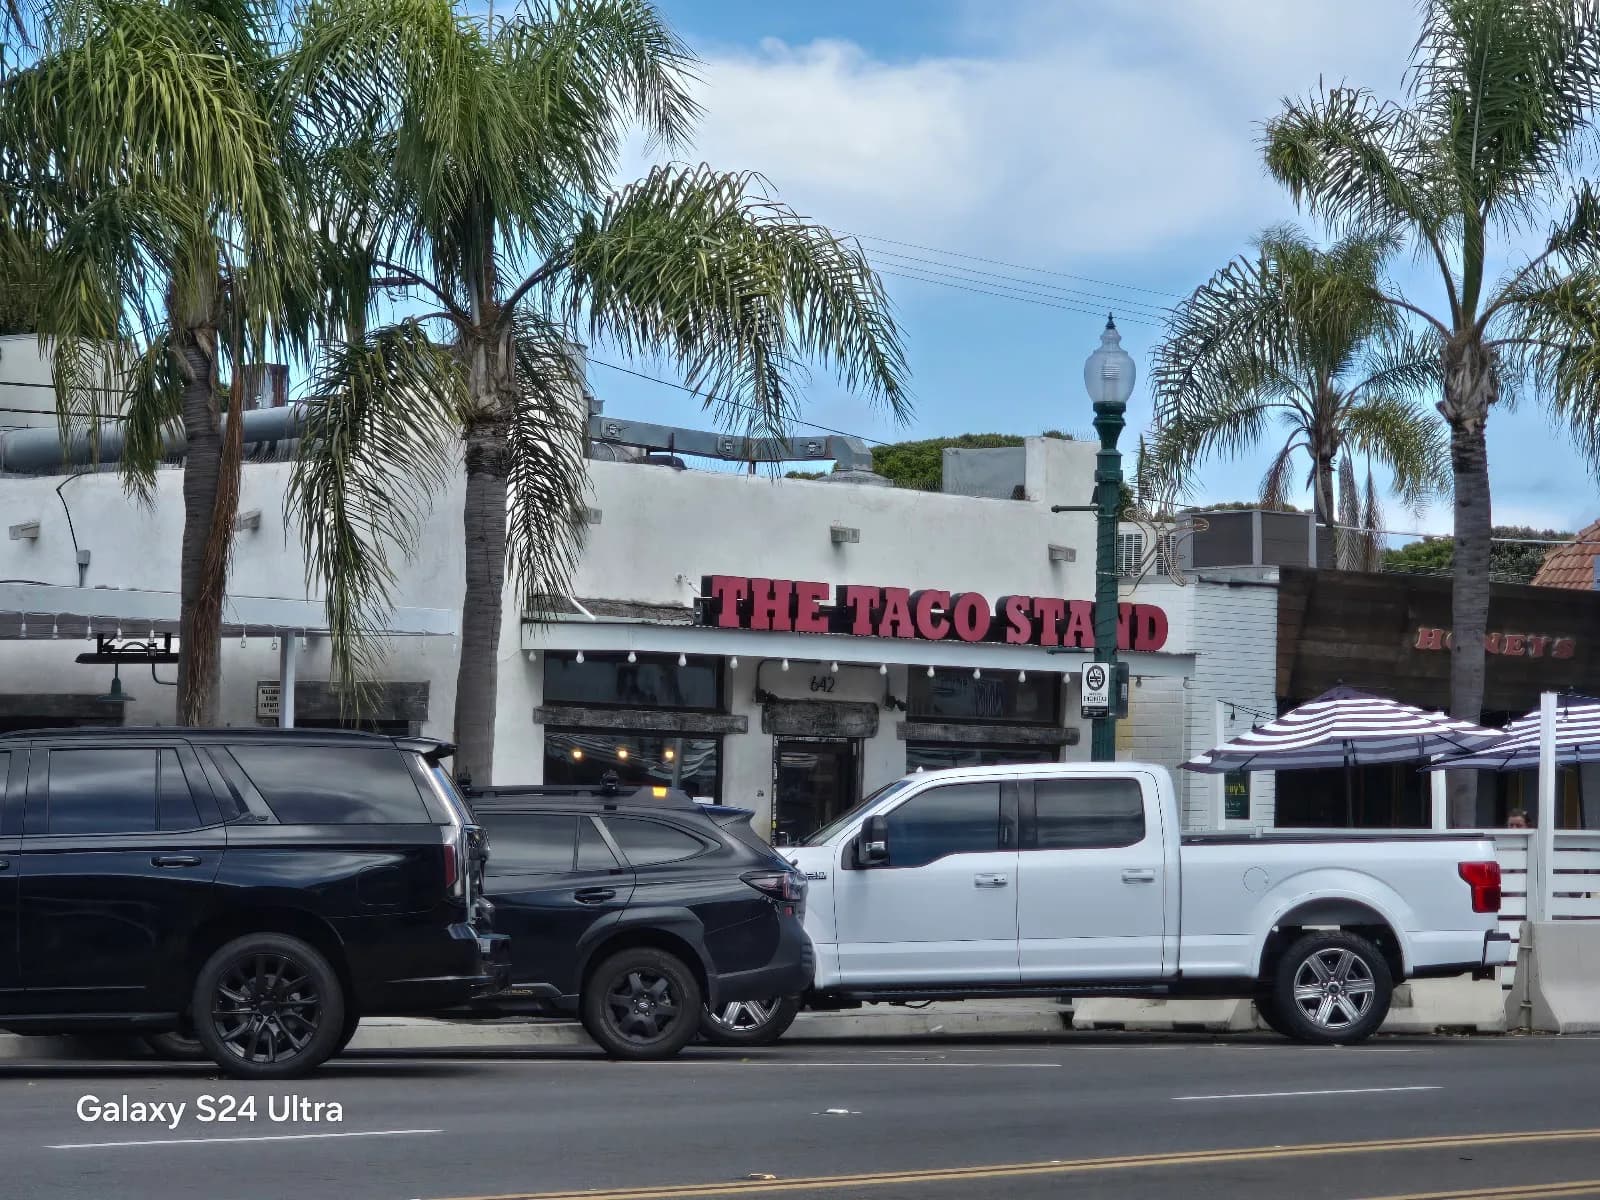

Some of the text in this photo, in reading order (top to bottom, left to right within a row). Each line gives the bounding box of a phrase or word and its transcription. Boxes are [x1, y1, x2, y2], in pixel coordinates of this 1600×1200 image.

[709, 574, 830, 633] THE
[844, 584, 991, 642] TACO
[810, 675, 835, 693] 642
